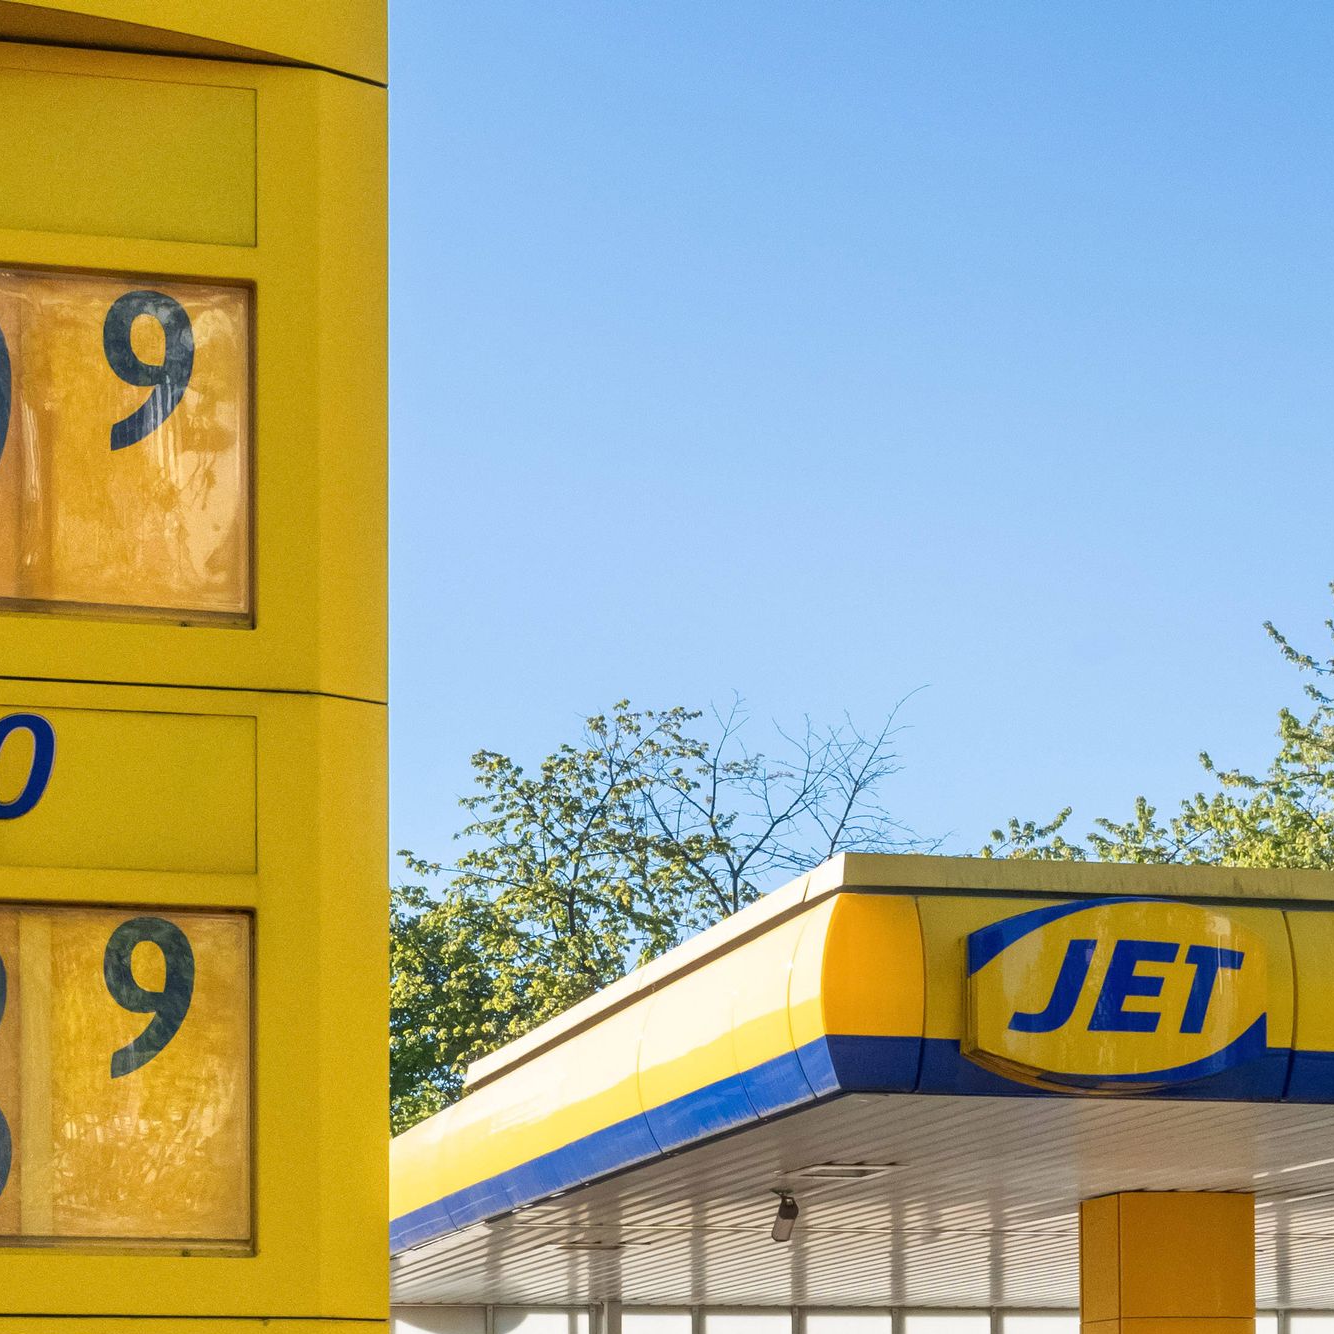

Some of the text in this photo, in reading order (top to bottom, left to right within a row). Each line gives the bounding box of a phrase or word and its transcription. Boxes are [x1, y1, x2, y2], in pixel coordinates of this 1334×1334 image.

[102, 289, 195, 453] 9
[102, 917, 195, 1080] 9
[1007, 939, 1245, 1034] JET
